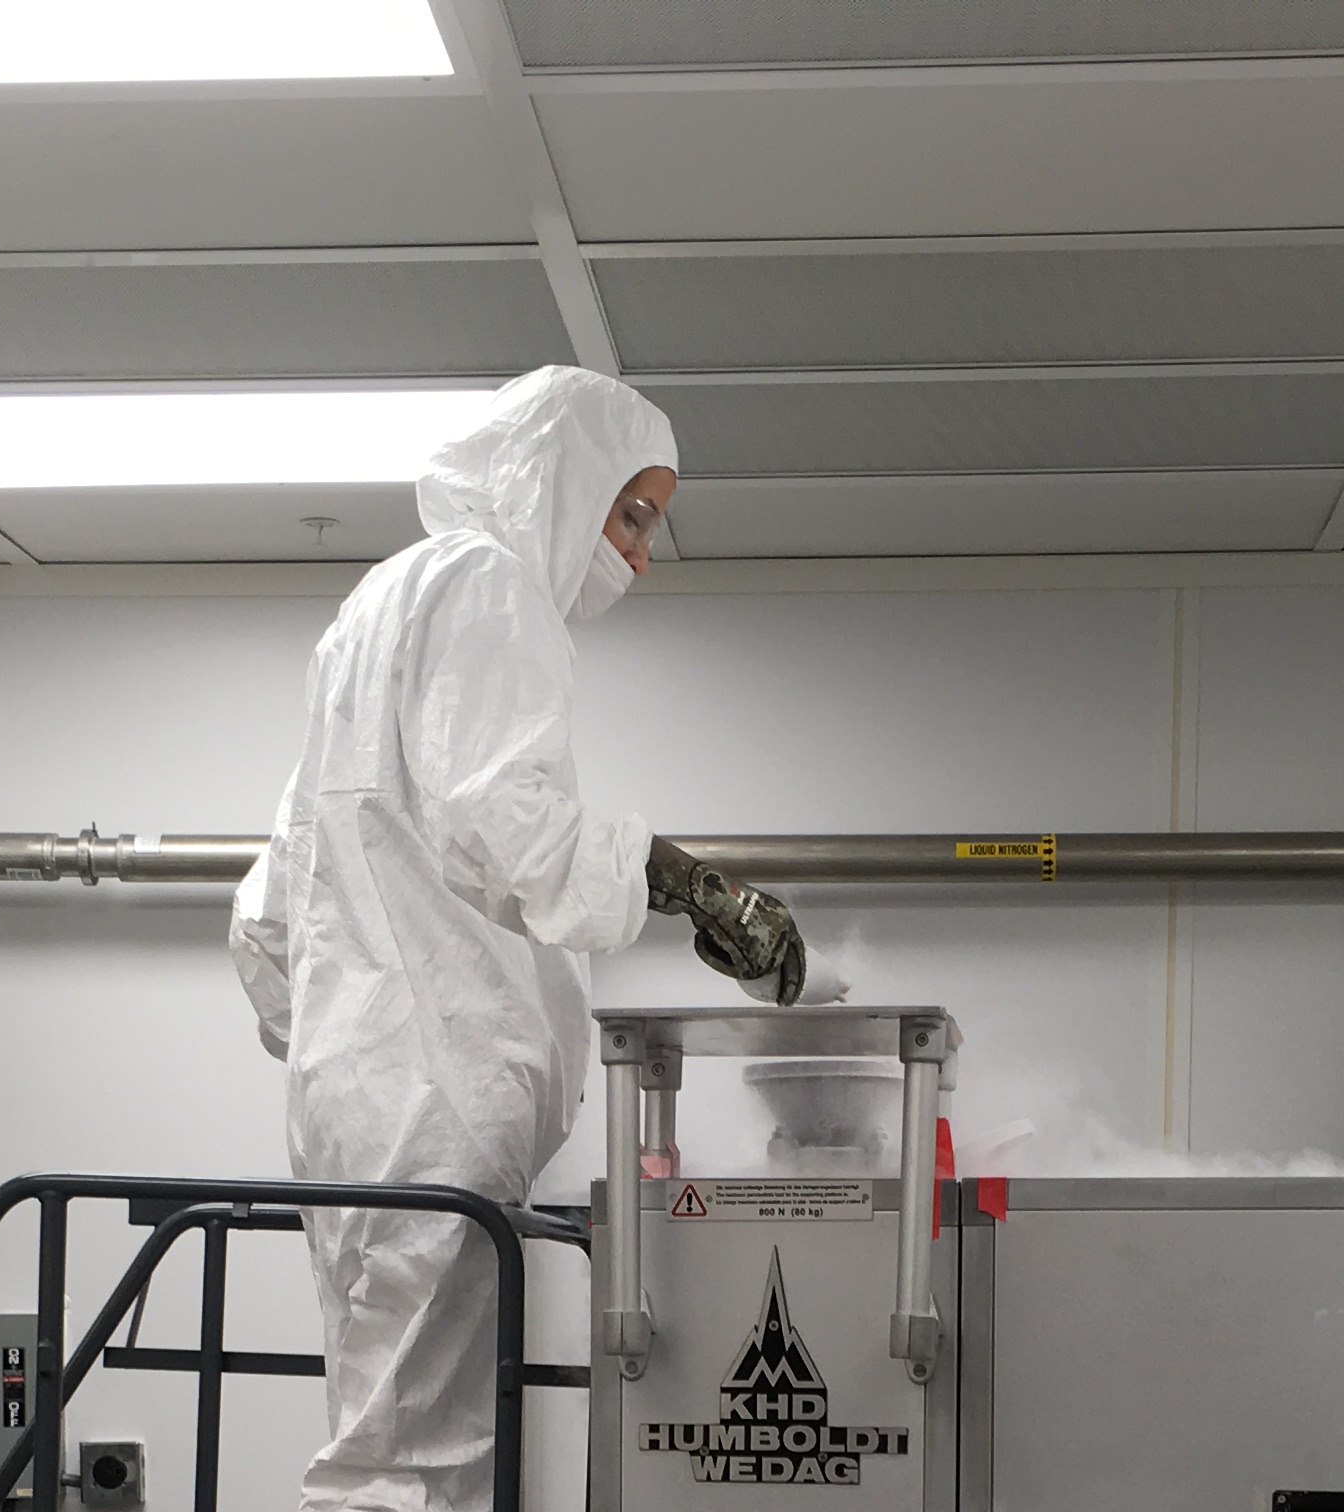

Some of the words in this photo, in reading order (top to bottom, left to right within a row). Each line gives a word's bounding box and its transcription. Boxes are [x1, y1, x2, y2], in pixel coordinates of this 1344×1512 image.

[969, 844, 996, 856] LIQUID
[998, 844, 1038, 856] NITROGEN
[778, 1207, 785, 1216] N
[809, 1207, 824, 1218] kg)
[8, 1348, 20, 1365] ON
[8, 1401, 20, 1427] OFF
[720, 1393, 826, 1421] KHD
[640, 1424, 909, 1455] HUMBOLDT
[690, 1455, 860, 1484] WEDAG
